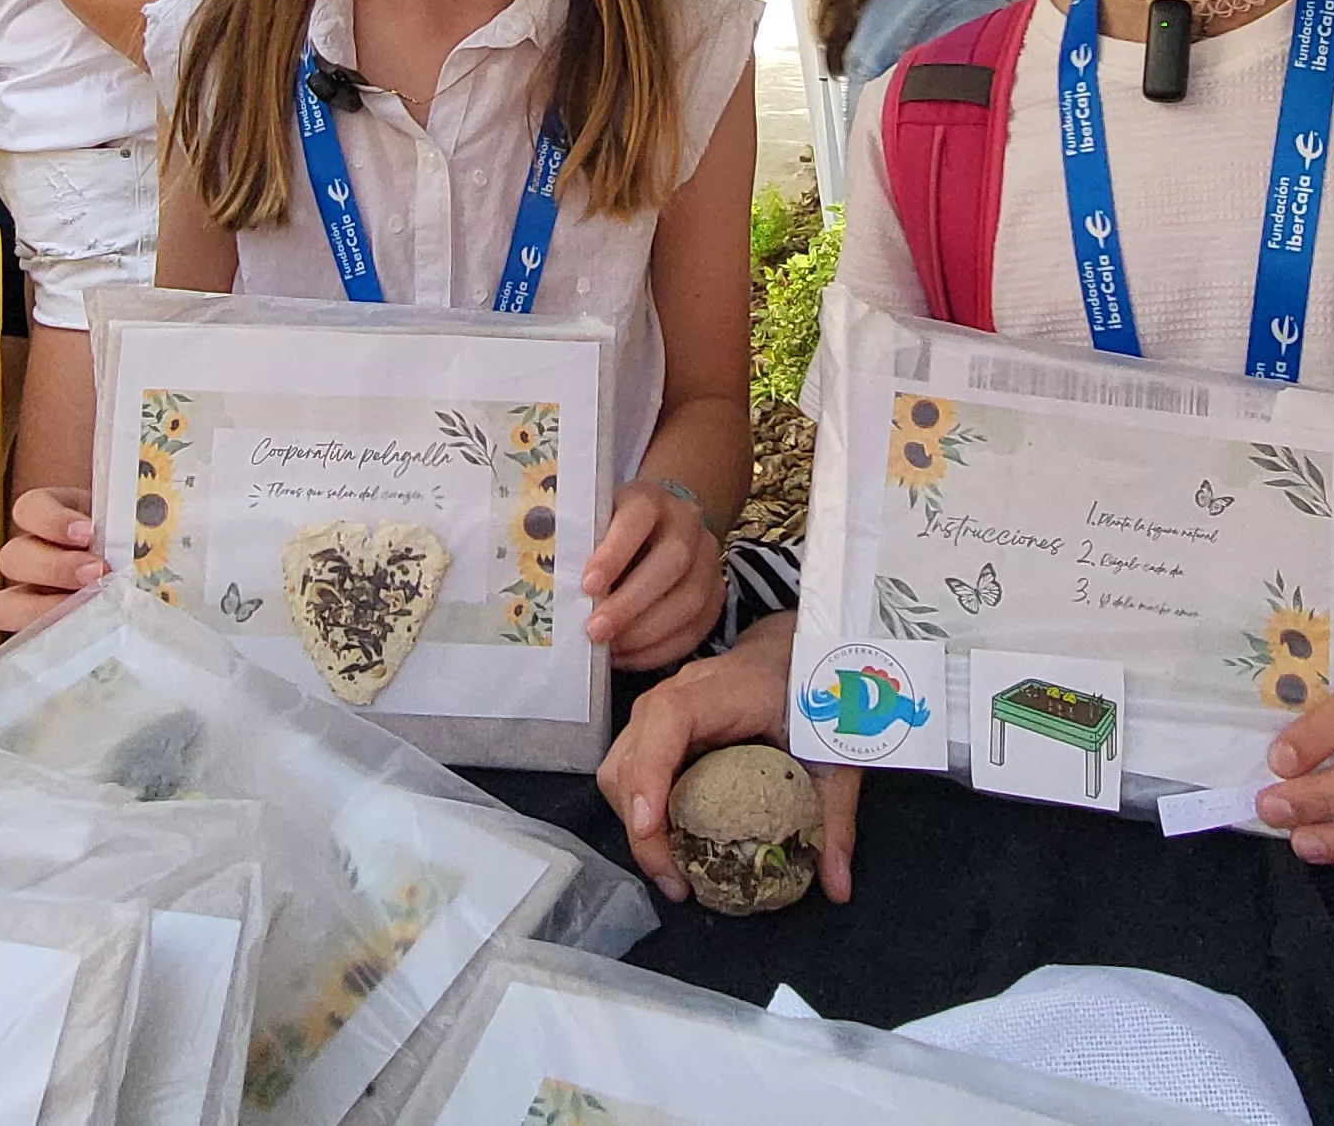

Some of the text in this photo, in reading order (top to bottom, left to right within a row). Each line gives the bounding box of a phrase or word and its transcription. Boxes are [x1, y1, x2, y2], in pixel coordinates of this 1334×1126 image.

[1294, 1, 1316, 69] Fundación
[540, 138, 566, 197] iberCaj
[1267, 175, 1291, 250] Fundación
[1285, 174, 1315, 253] iberCaja
[331, 222, 353, 280] Fundación
[342, 214, 367, 276] iberCaja
[510, 281, 529, 314] Caja
[1082, 260, 1106, 332] Fundación
[1097, 254, 1123, 329] iberCaja
[251, 437, 357, 469] Cooperativa
[917, 510, 1065, 556] Instrucciones
[1076, 539, 1096, 567] 2.
[1072, 577, 1091, 606] 3.
